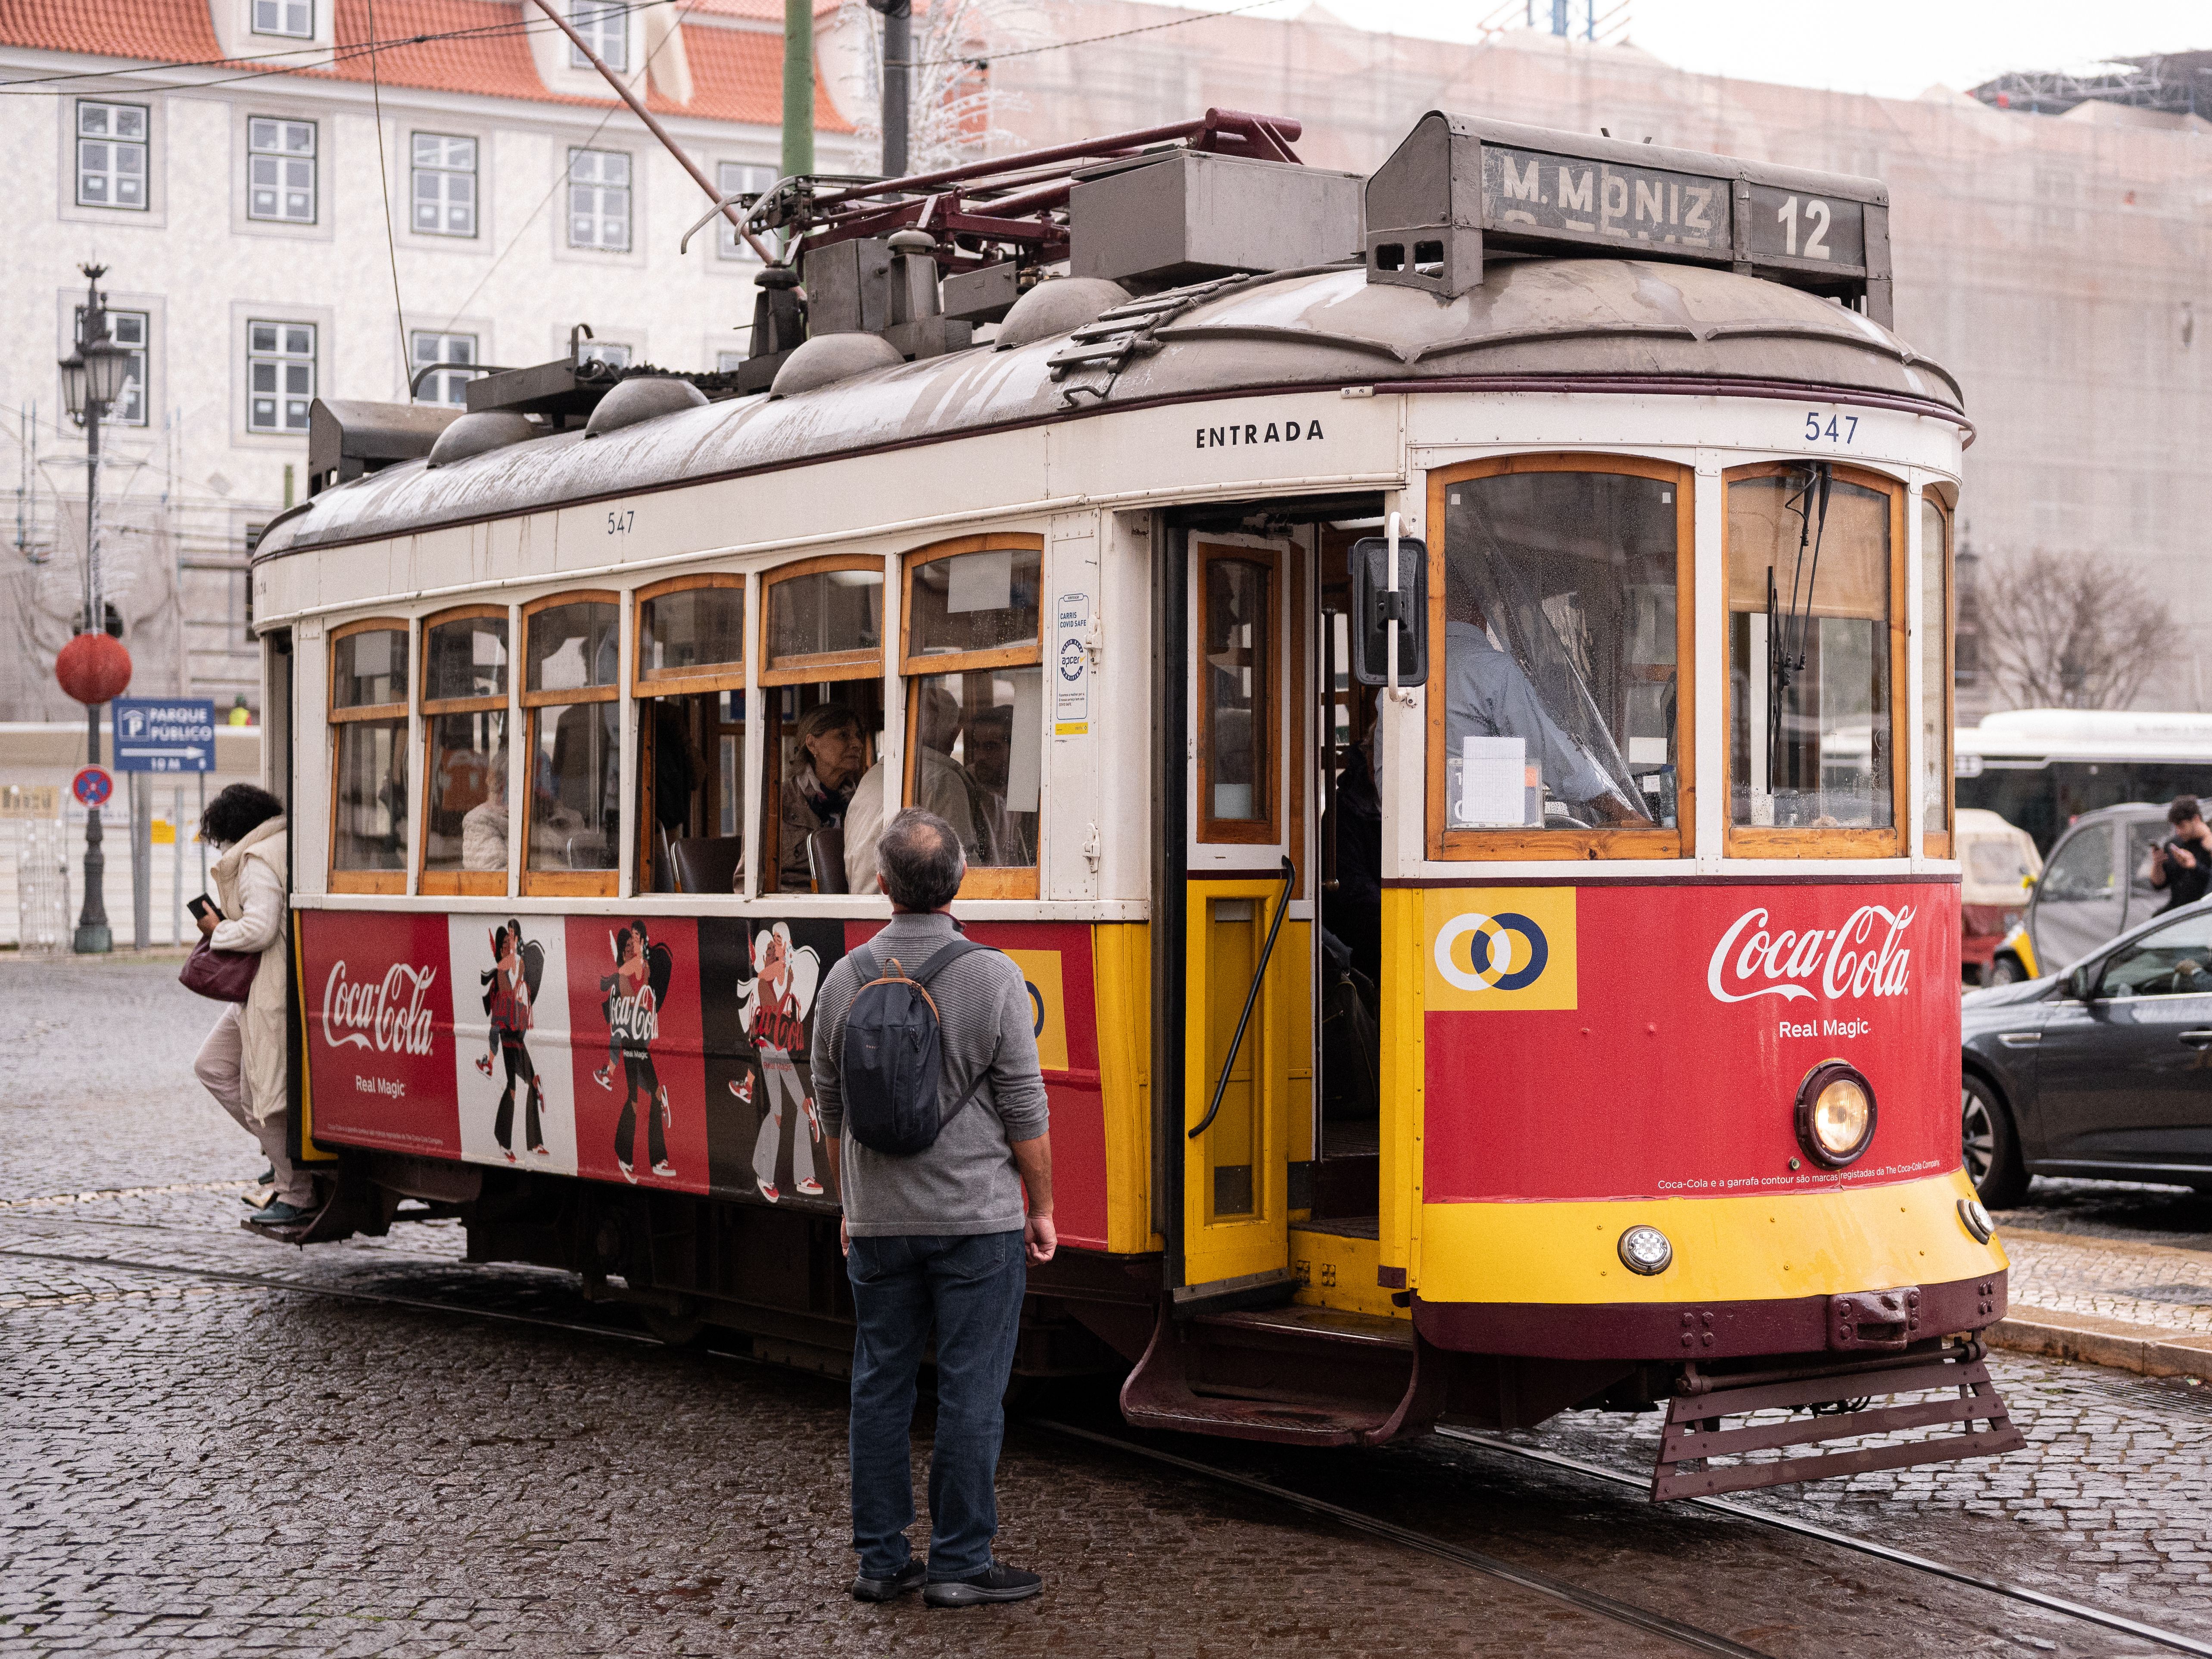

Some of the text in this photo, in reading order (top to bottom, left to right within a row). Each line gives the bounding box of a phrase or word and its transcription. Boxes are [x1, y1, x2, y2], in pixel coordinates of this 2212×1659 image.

[1778, 196, 1831, 259] 12
[1196, 420, 1324, 448] ENTRADA
[1805, 412, 1858, 444] 547
[608, 510, 634, 534] 547
[1062, 640, 1072, 653] COVID
[1062, 656, 1079, 667] apcer
[1063, 670, 1081, 680] VERIFIED
[151, 708, 207, 723] PARQUE
[151, 724, 212, 742] PÚBLICO
[1707, 904, 1917, 1003] Coca-Cola
[323, 960, 437, 1056] Coca-Cola
[1779, 1017, 1869, 1038] Real Magic
[623, 1049, 648, 1060] Real Magic
[356, 1075, 405, 1098] Real Magic
[1658, 1179, 1708, 1188] Coca-Cola
[1727, 1177, 1759, 1188] garrafa
[1761, 1176, 1794, 1184] contour
[1841, 1169, 1875, 1180] registadas
[1877, 1167, 1884, 1176] da
[1886, 1166, 1896, 1174] The
[1897, 1162, 1922, 1173] Coca-Cola
